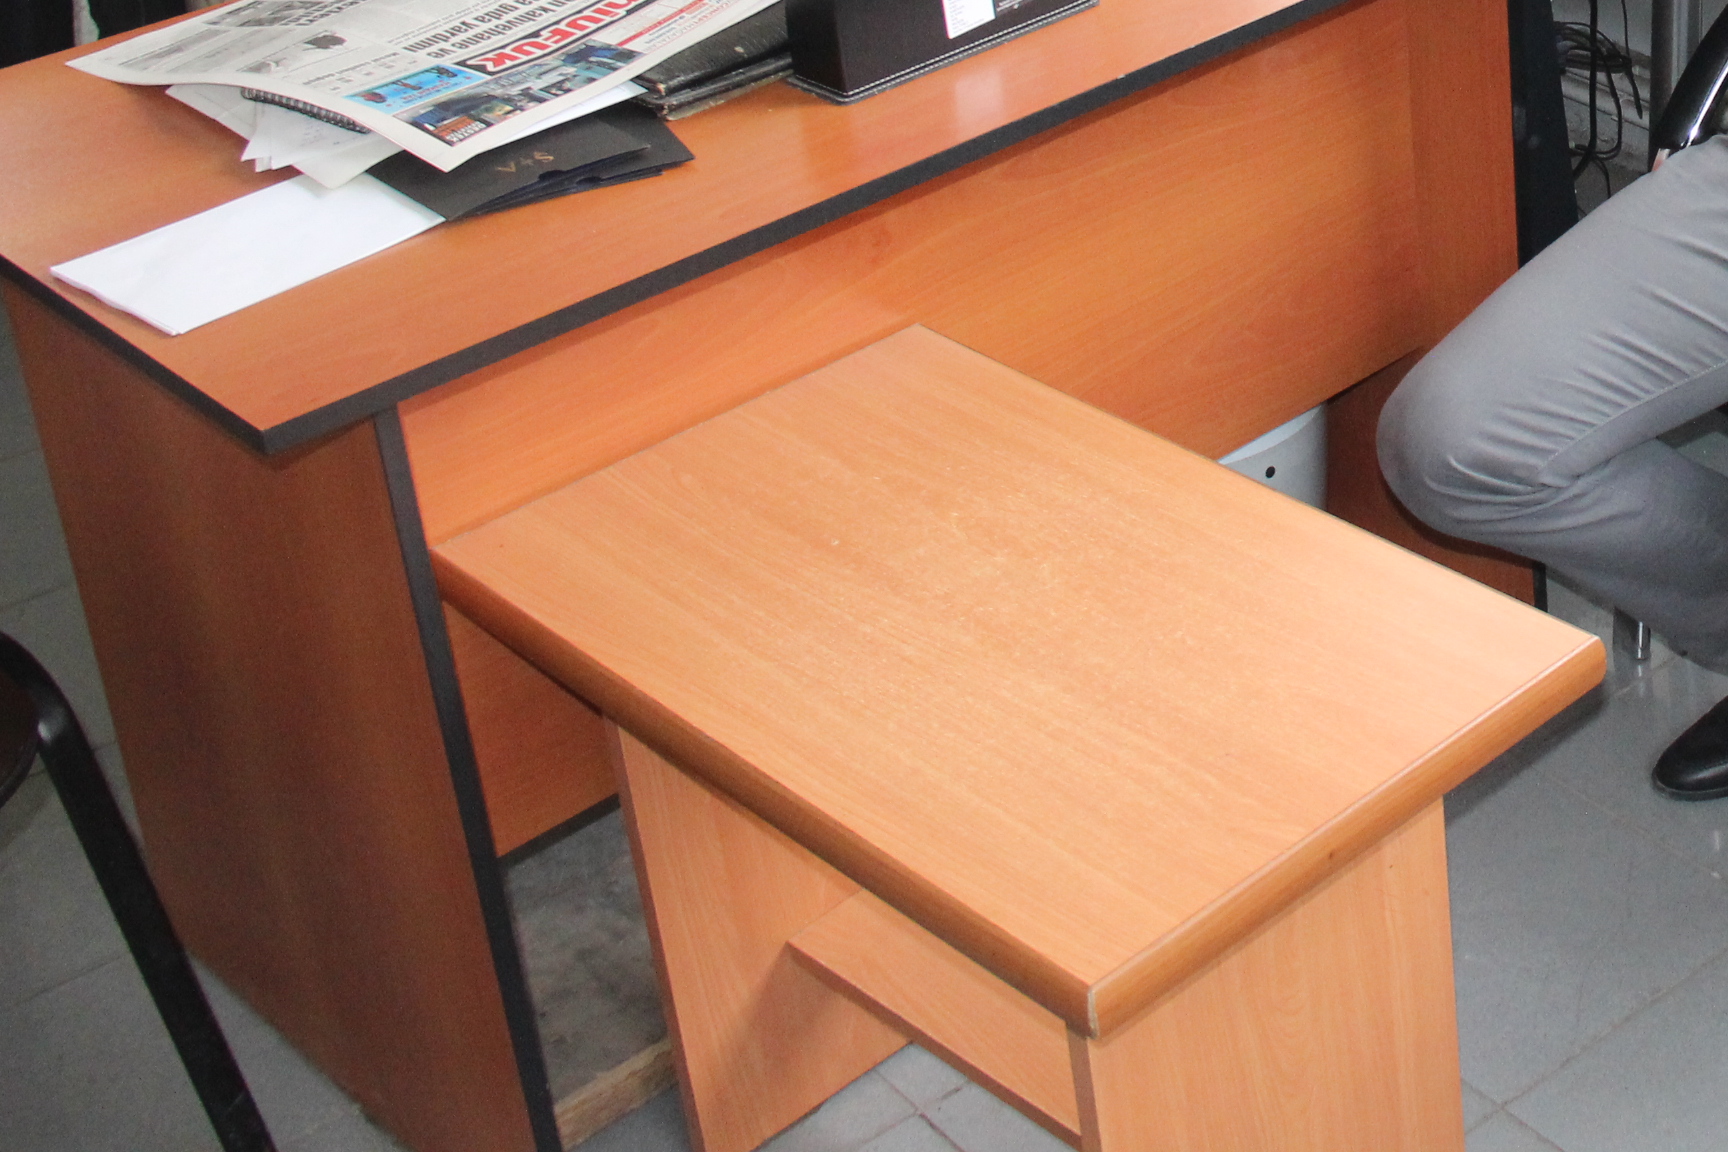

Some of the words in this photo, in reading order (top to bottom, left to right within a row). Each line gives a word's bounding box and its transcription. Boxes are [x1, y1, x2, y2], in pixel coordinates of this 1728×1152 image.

[468, 3, 521, 20] gıda
[402, 20, 479, 53] yardımı
[446, 5, 556, 49] kahvehane
[425, 47, 456, 58] ve
